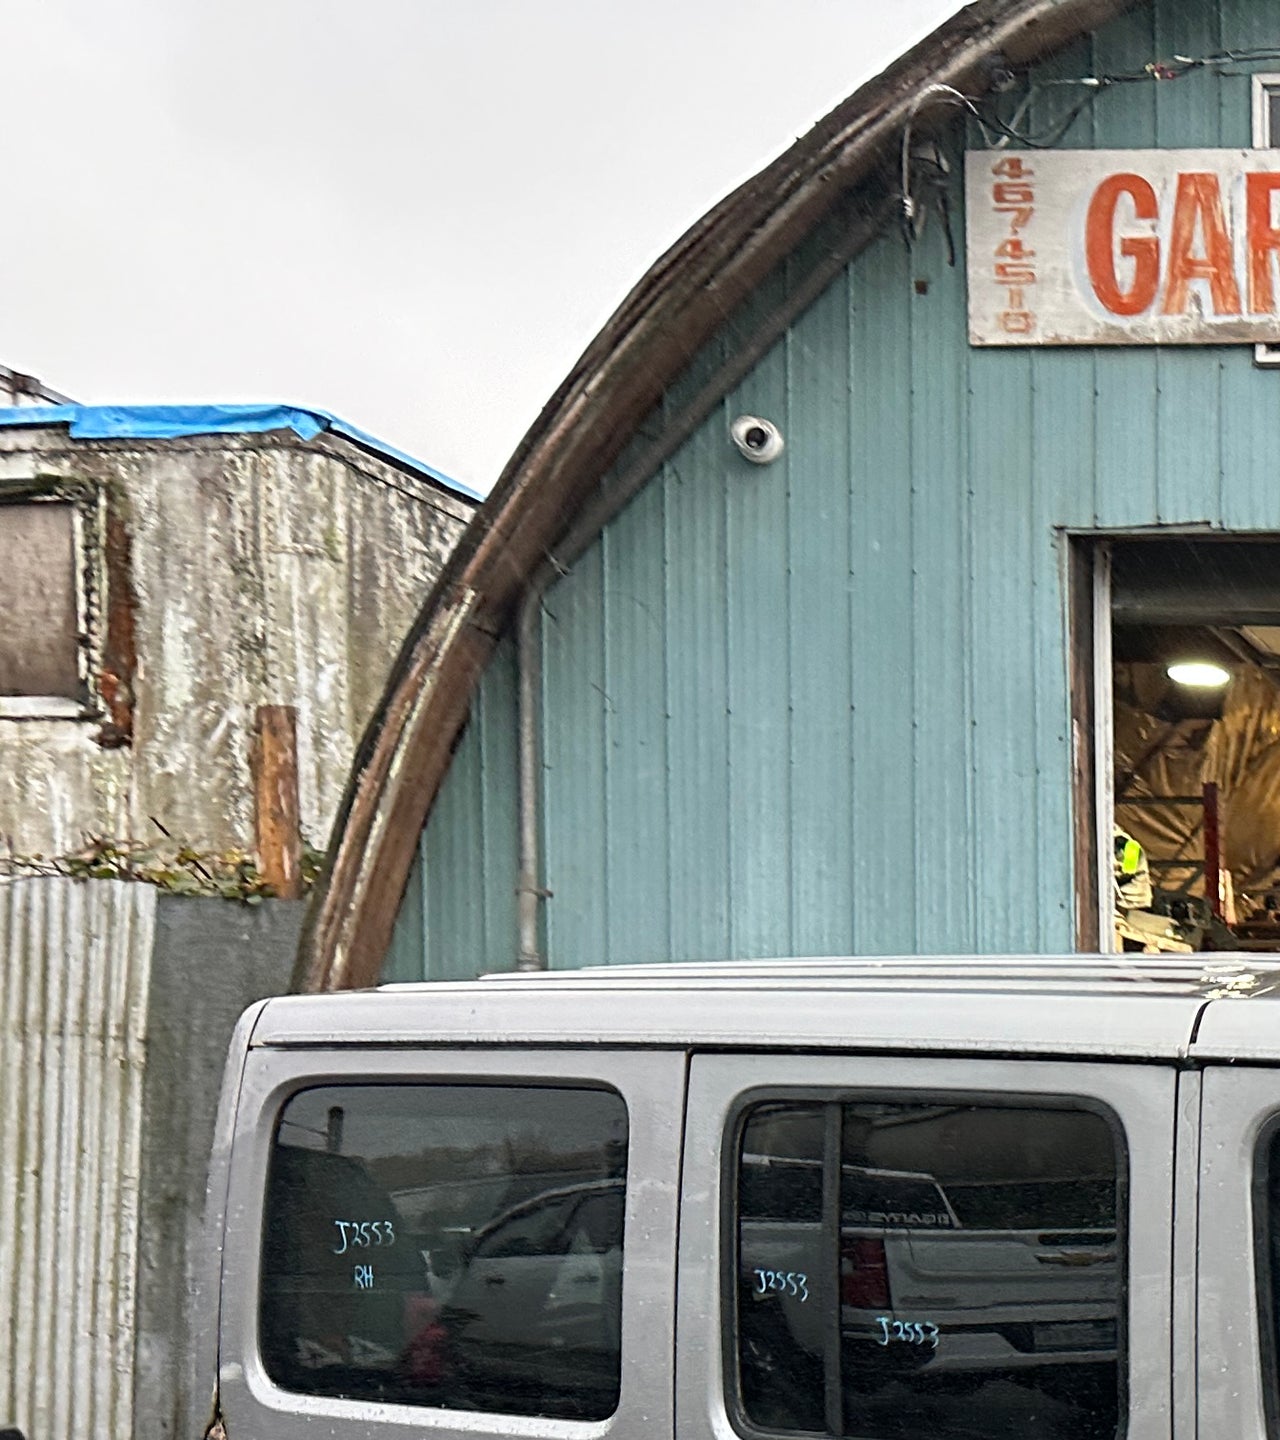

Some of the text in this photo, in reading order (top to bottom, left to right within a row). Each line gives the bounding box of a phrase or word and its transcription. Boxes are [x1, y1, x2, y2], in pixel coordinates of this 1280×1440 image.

[334, 1220, 395, 1254] J2553
[354, 1265, 374, 1289] RH
[754, 1269, 809, 1302] J2553
[875, 1316, 940, 1349] J2553
